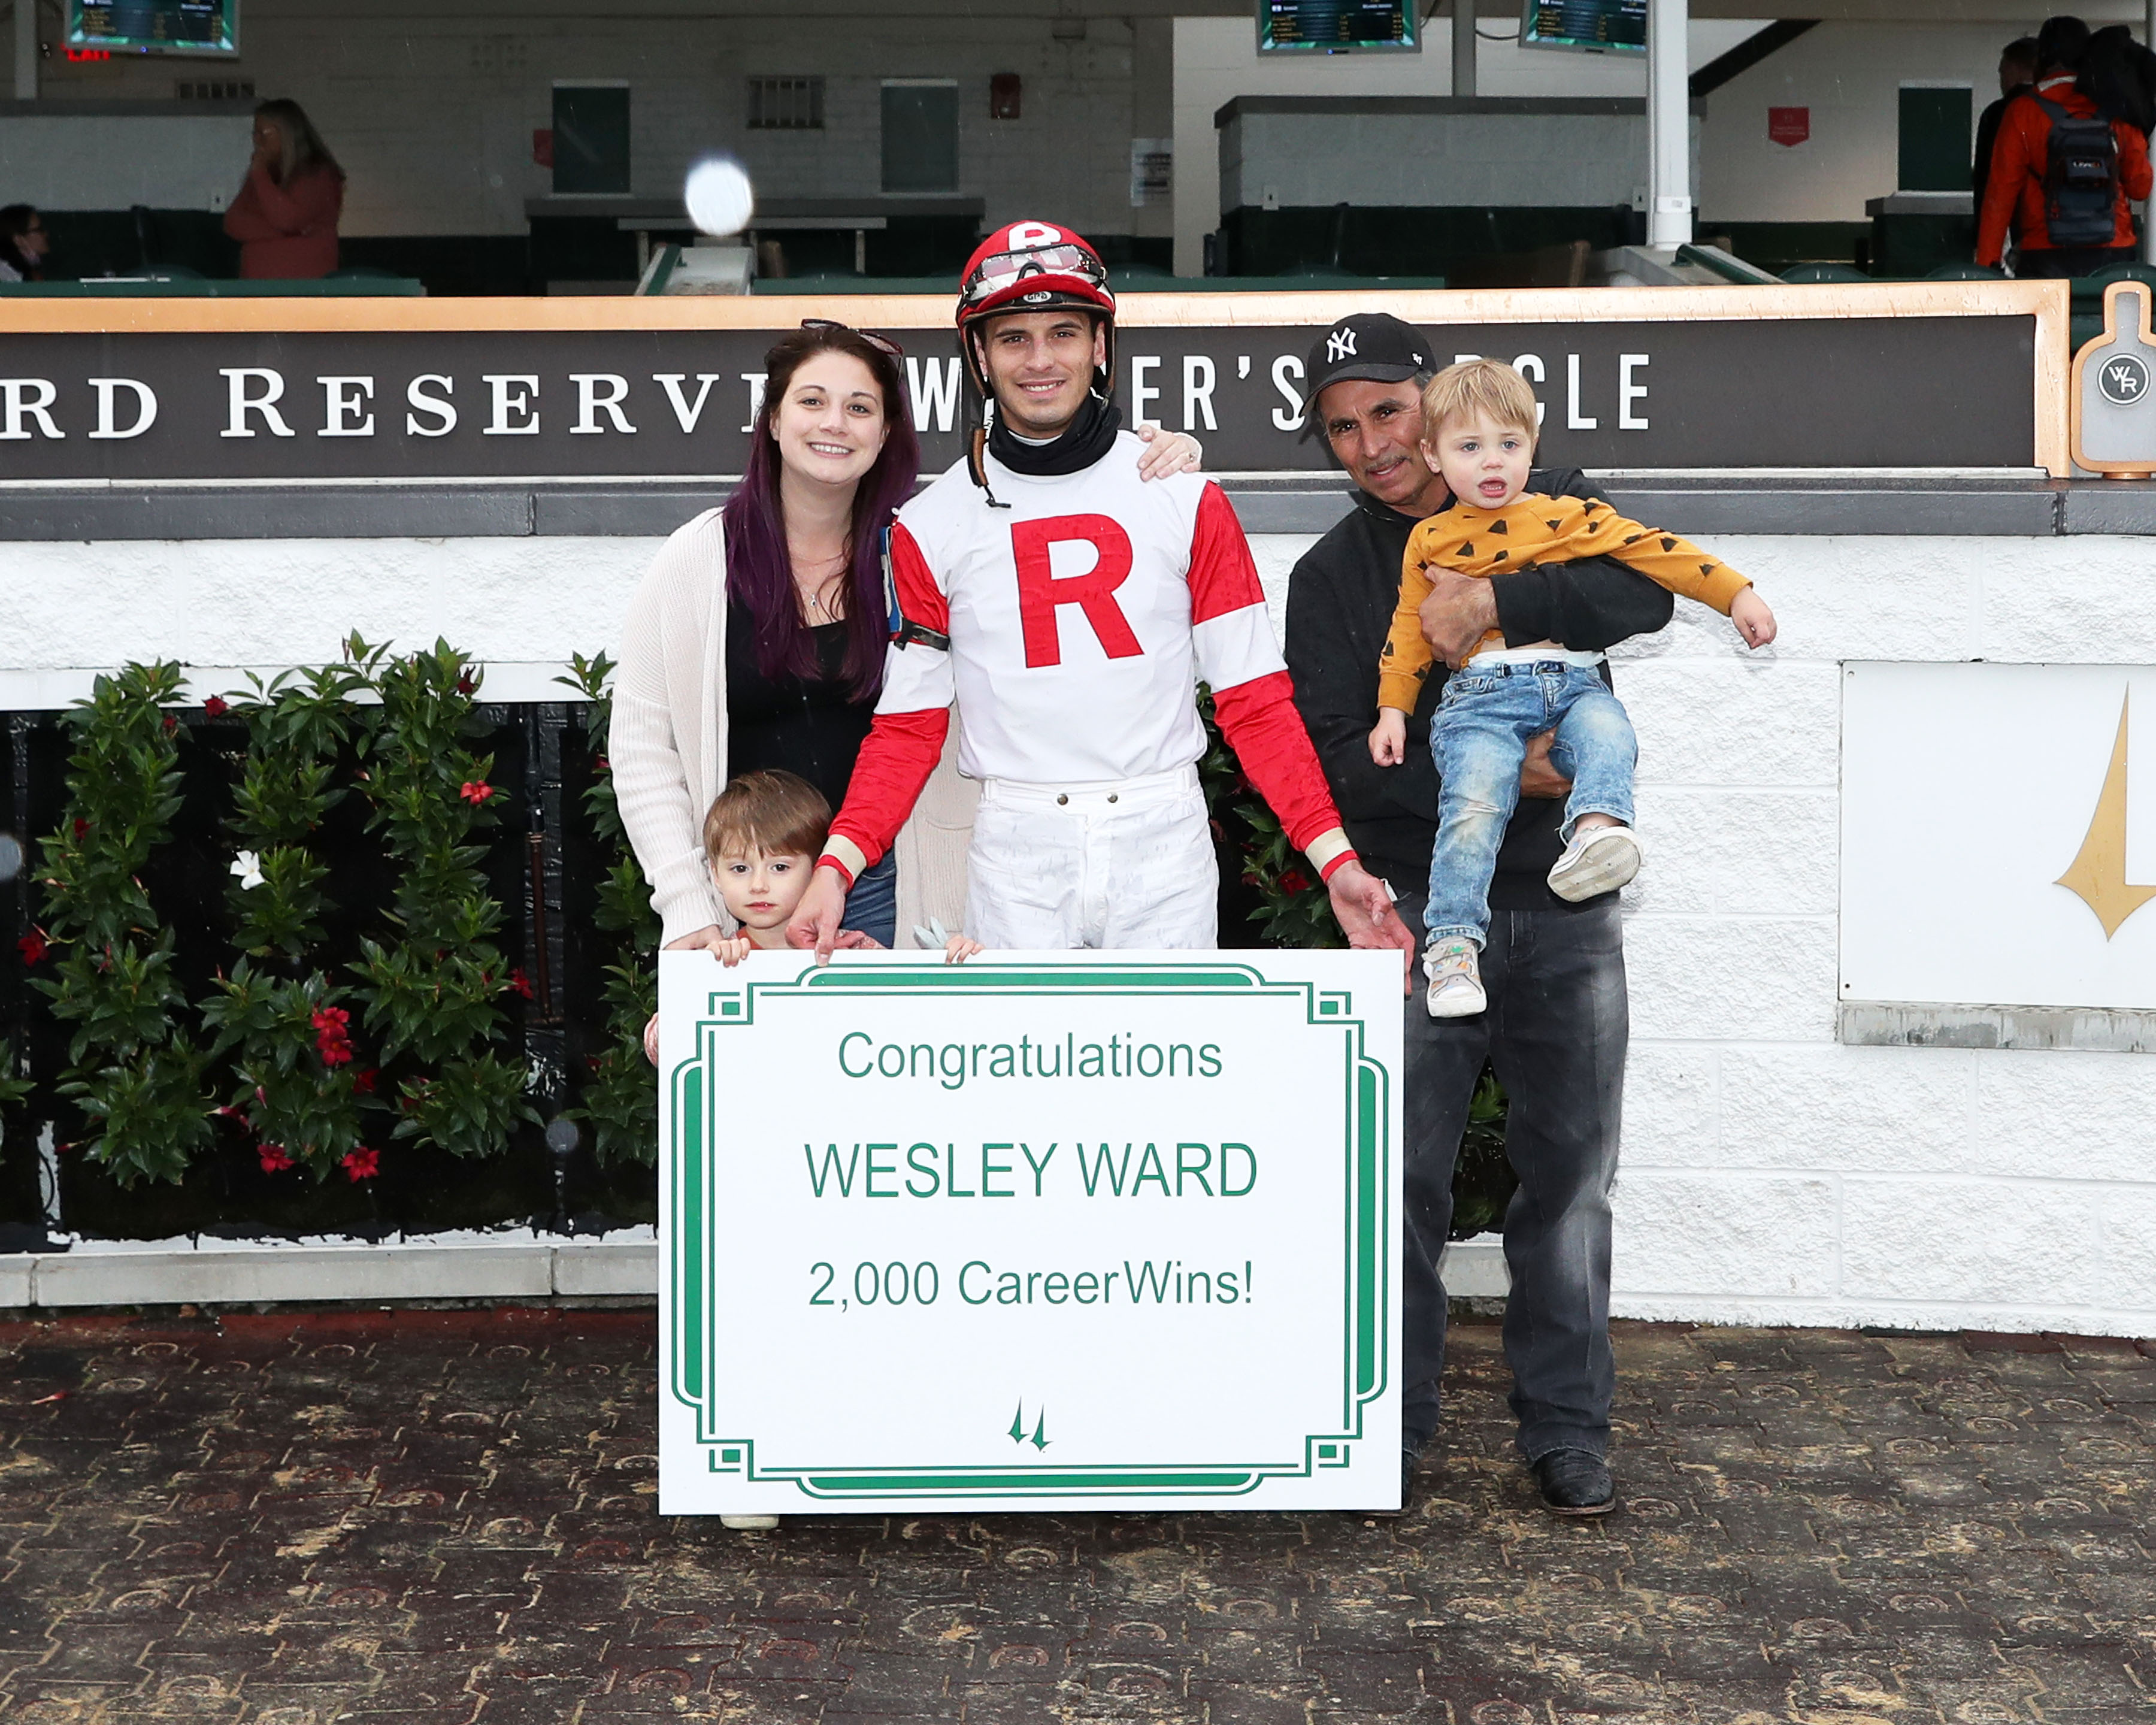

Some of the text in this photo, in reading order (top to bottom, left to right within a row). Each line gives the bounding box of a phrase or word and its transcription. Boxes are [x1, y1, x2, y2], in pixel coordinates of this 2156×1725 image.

[1327, 327, 1357, 364] NY
[905, 355, 1306, 432] WER'S
[2108, 365, 2137, 394] WR
[1010, 513, 1144, 668] R
[838, 1031, 1222, 1090] Congratulations
[804, 1142, 1257, 1199] WESLEY WARD
[808, 1261, 939, 1313] 2,000
